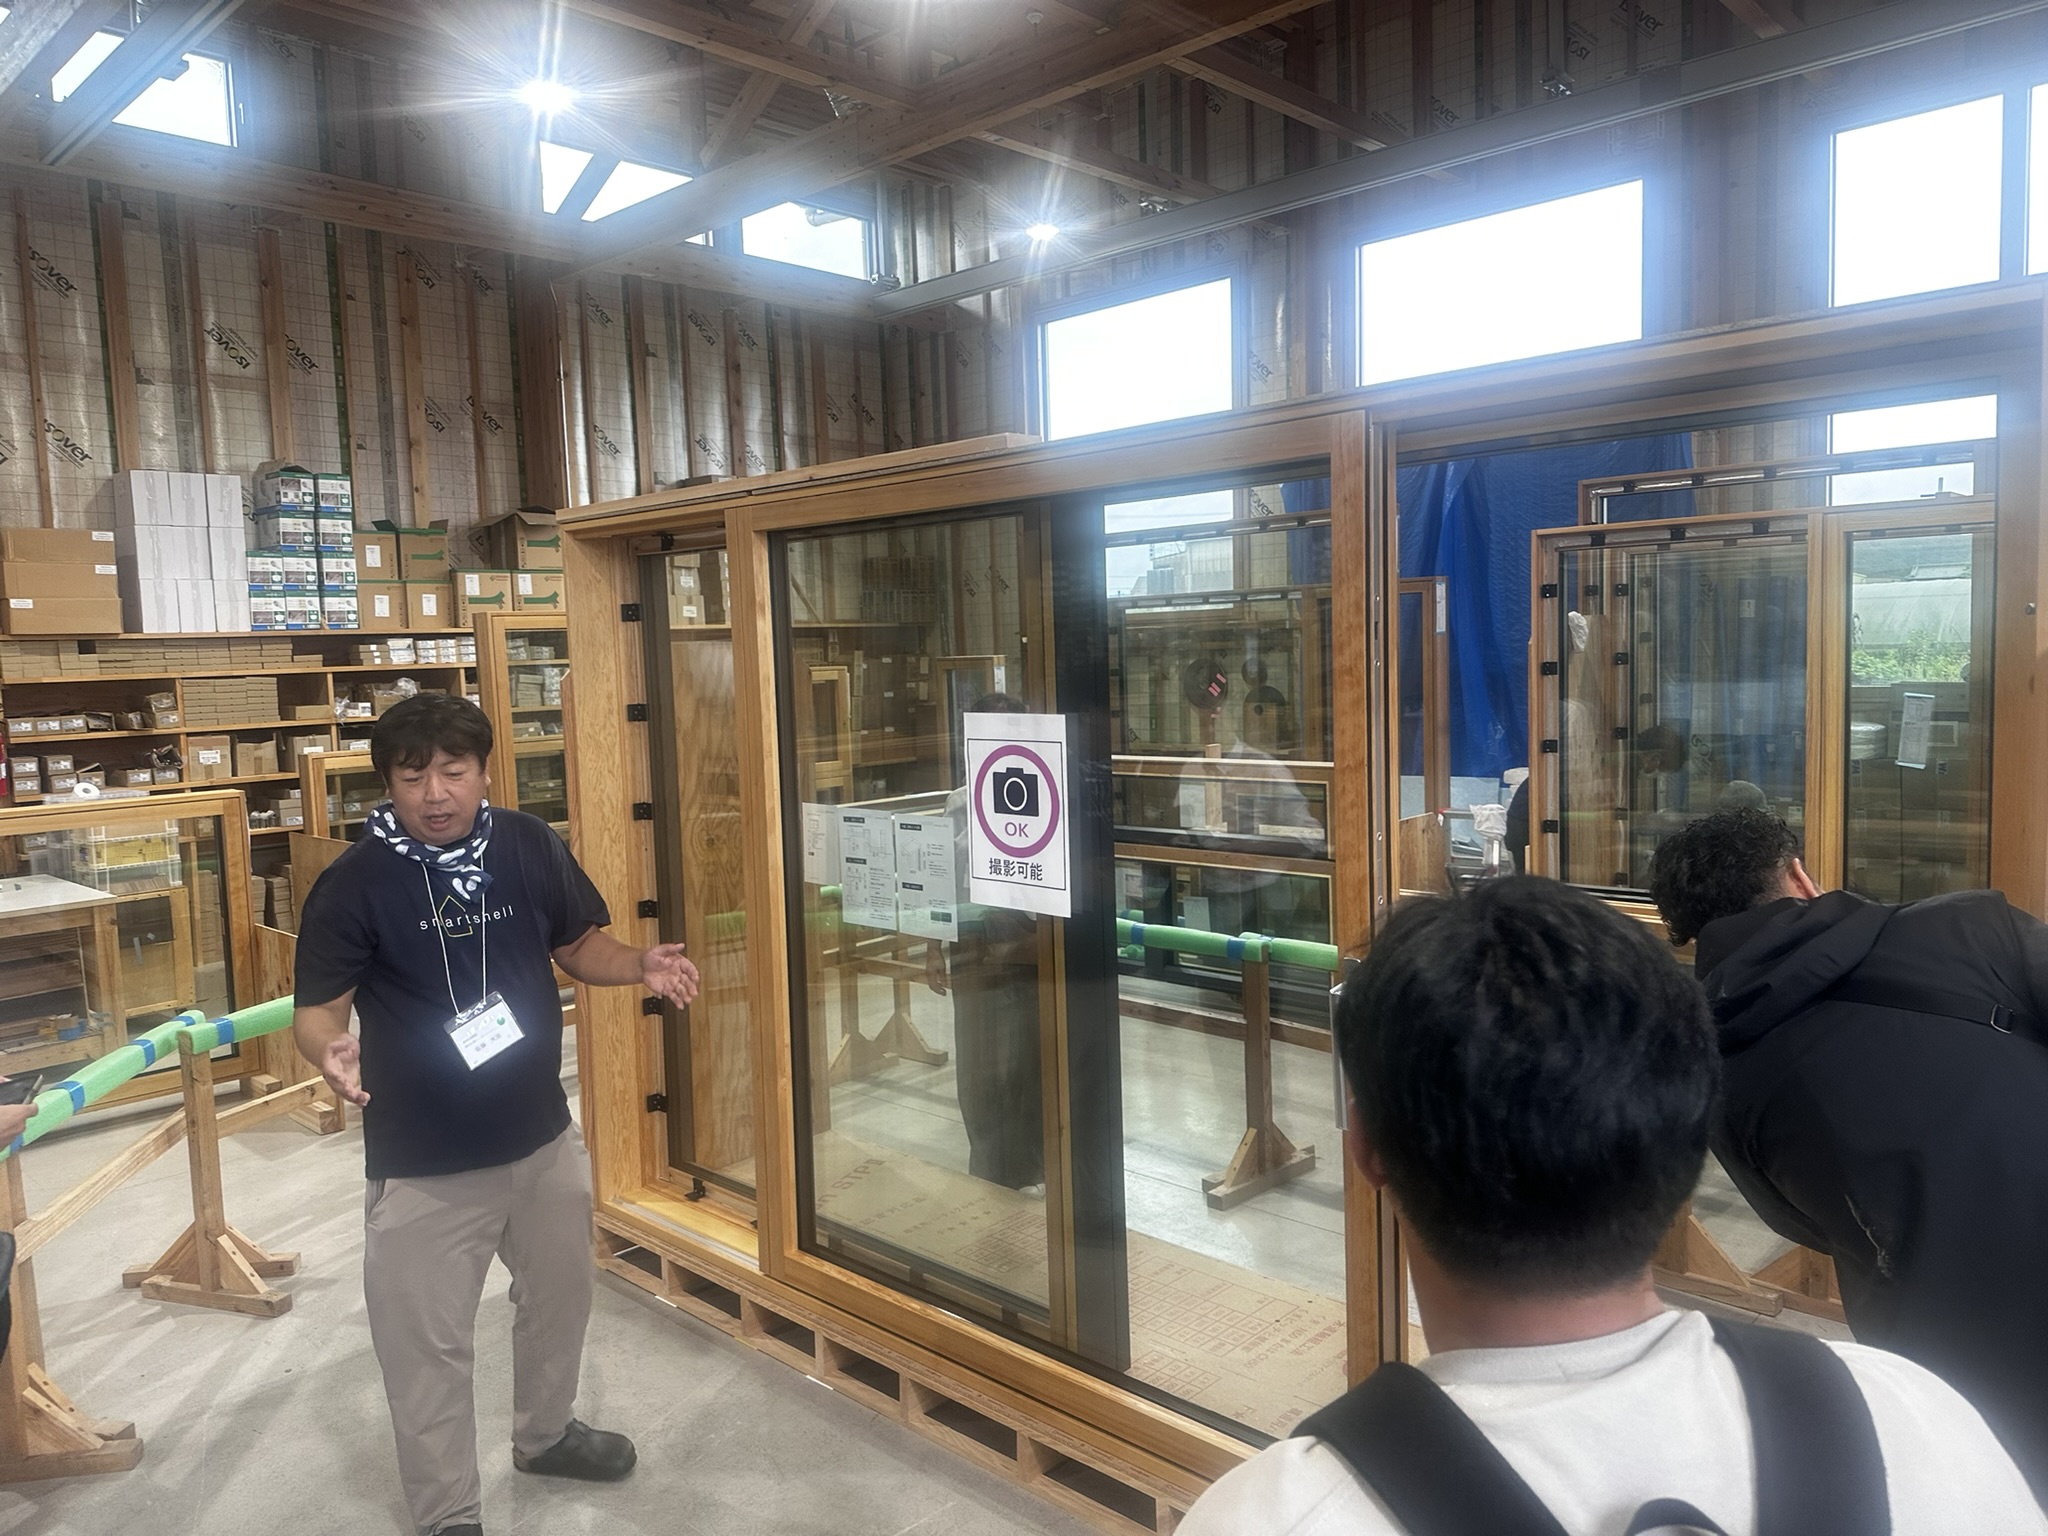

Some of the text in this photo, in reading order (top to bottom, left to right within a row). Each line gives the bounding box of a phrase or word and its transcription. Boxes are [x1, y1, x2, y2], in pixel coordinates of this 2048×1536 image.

[1004, 821, 1029, 839] OK
[989, 857, 1043, 882] 撮影可能
